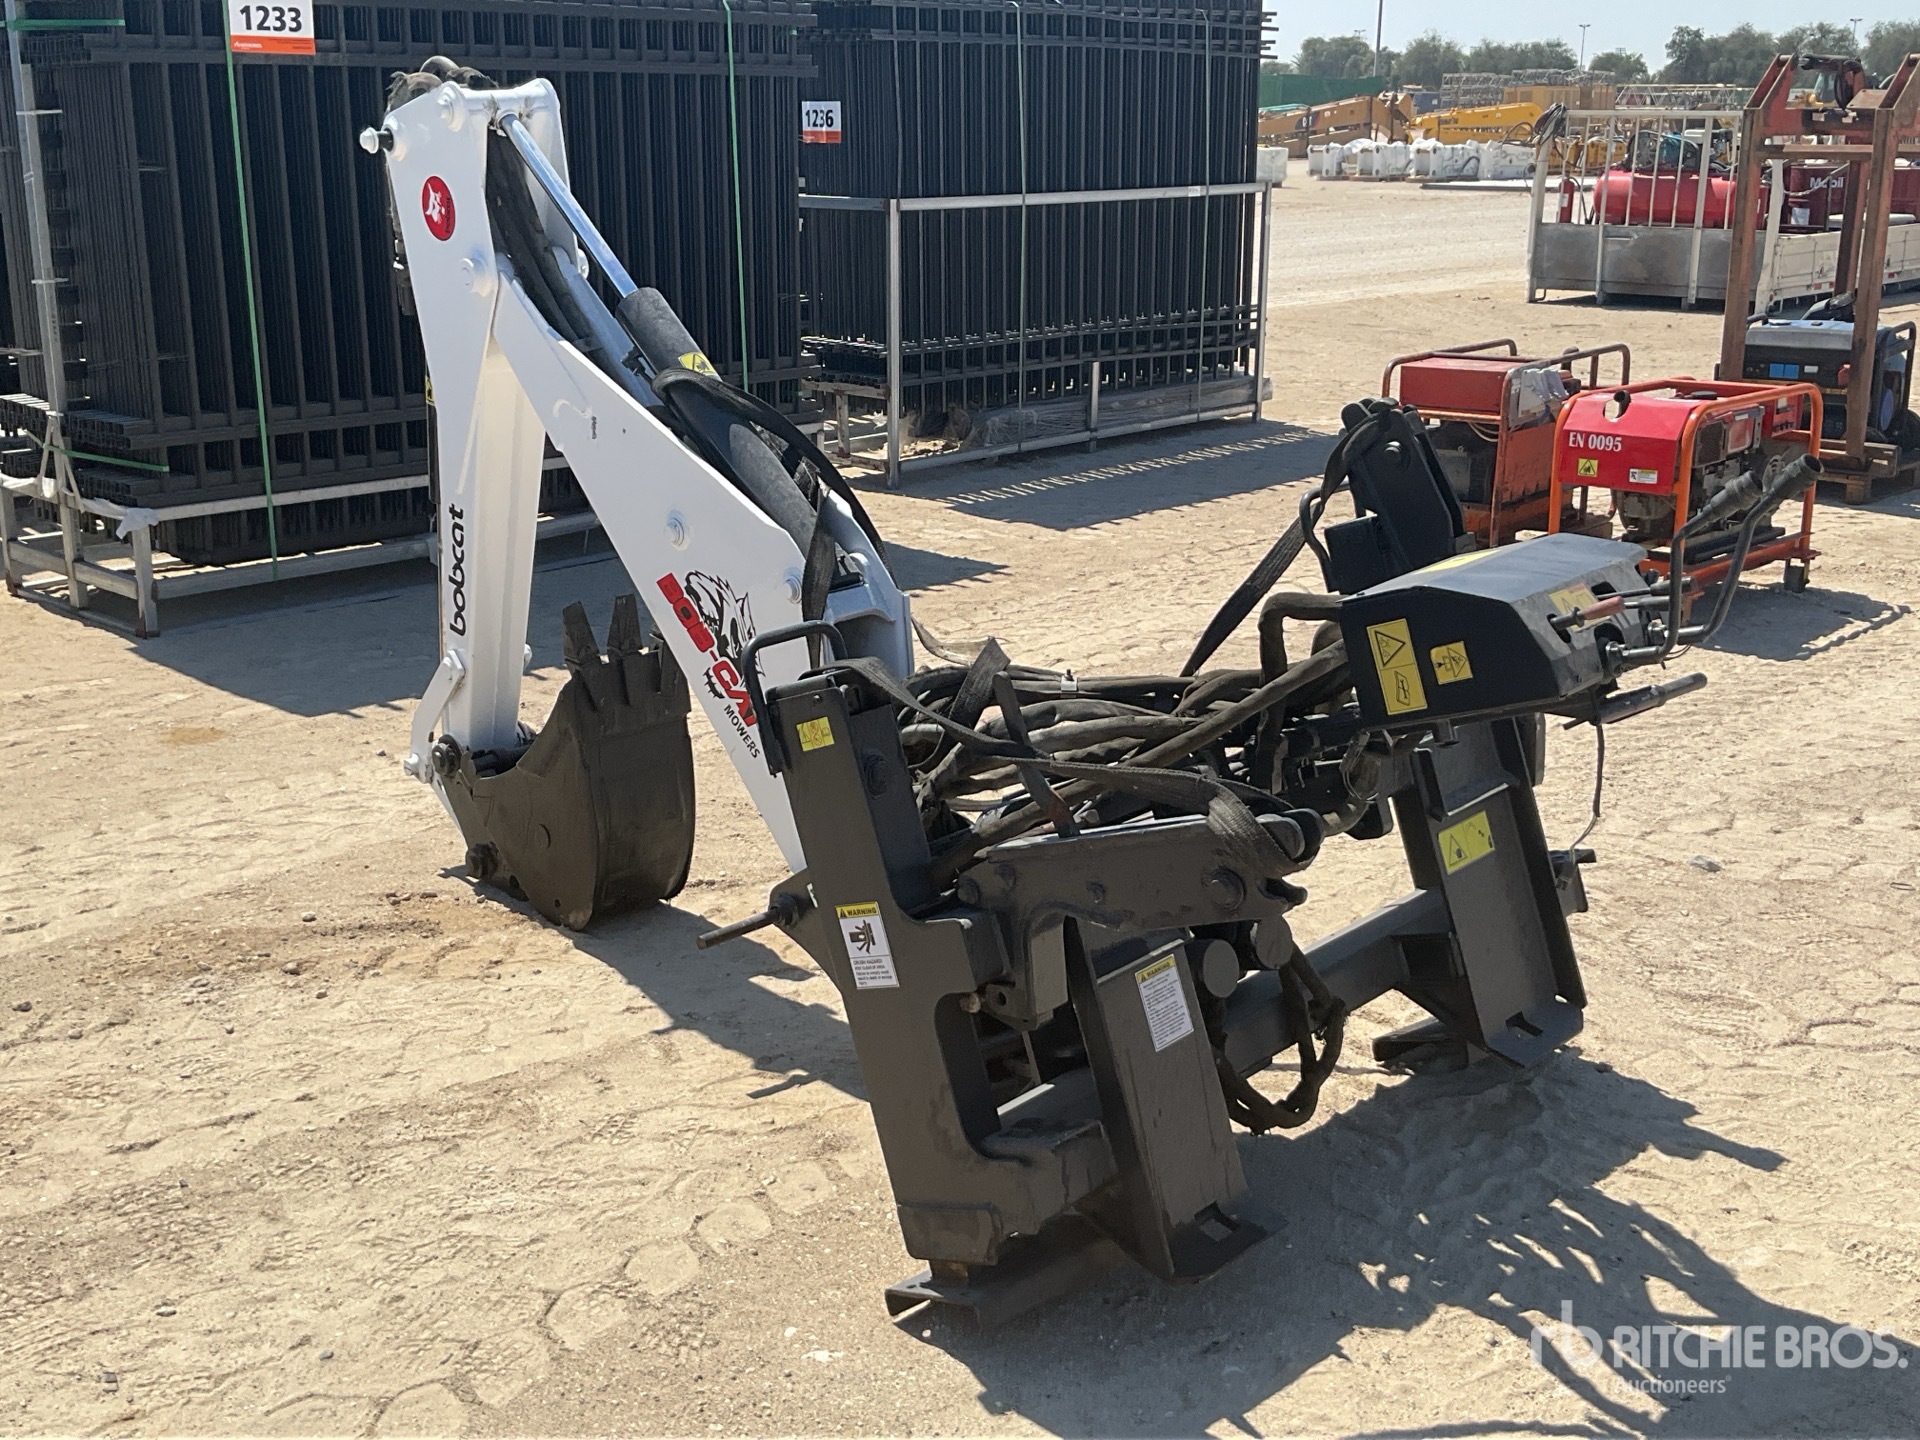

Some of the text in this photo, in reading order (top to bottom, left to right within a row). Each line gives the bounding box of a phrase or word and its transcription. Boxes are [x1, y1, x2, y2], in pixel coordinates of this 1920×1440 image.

[239, 5, 302, 32] 1233
[805, 109, 834, 128] 1236
[1569, 431, 1622, 452] EN 0095
[448, 503, 466, 636] bobcat
[723, 704, 760, 758] MOWERS
[847, 907, 877, 916] WARNING
